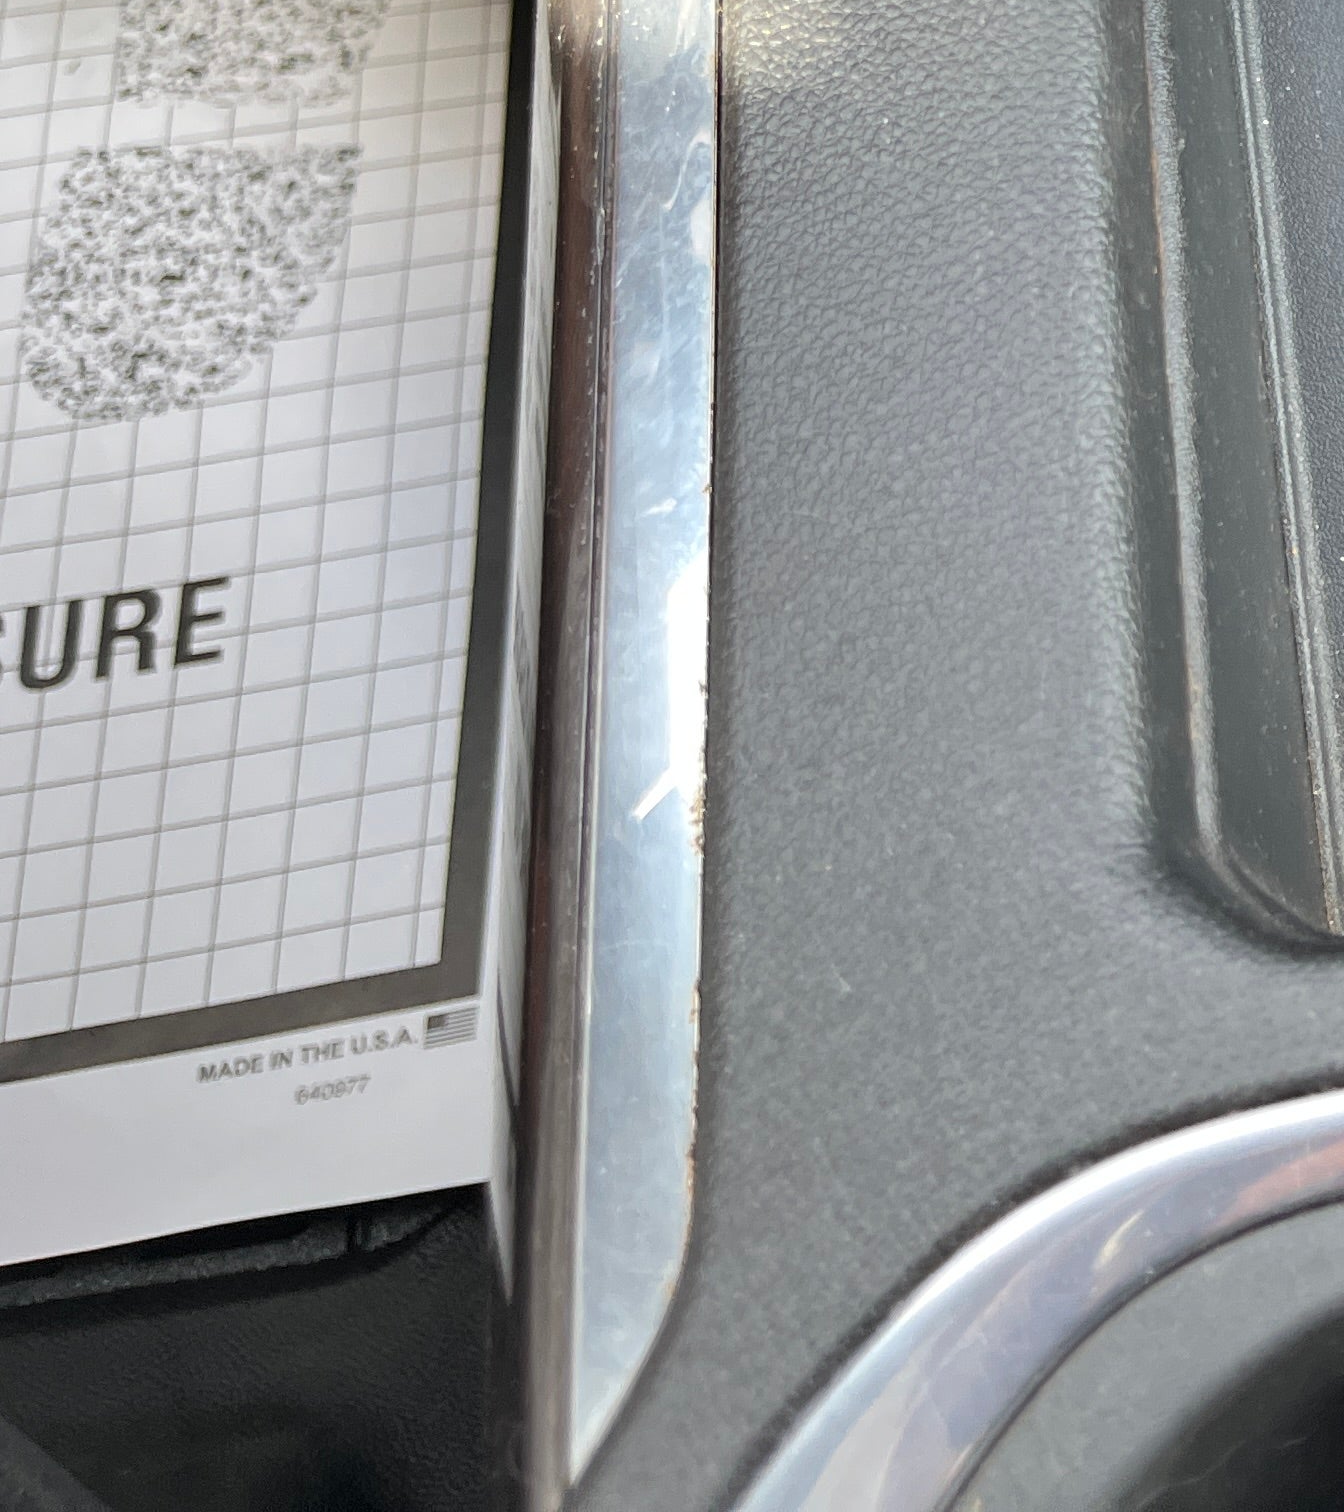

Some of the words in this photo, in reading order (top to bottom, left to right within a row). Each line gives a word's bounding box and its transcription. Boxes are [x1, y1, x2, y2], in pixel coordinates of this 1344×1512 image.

[0, 575, 231, 691] URE
[197, 1055, 263, 1082] MADE
[268, 1050, 293, 1071] IN
[301, 1040, 344, 1065] THE
[351, 1026, 417, 1056] U.S.A.
